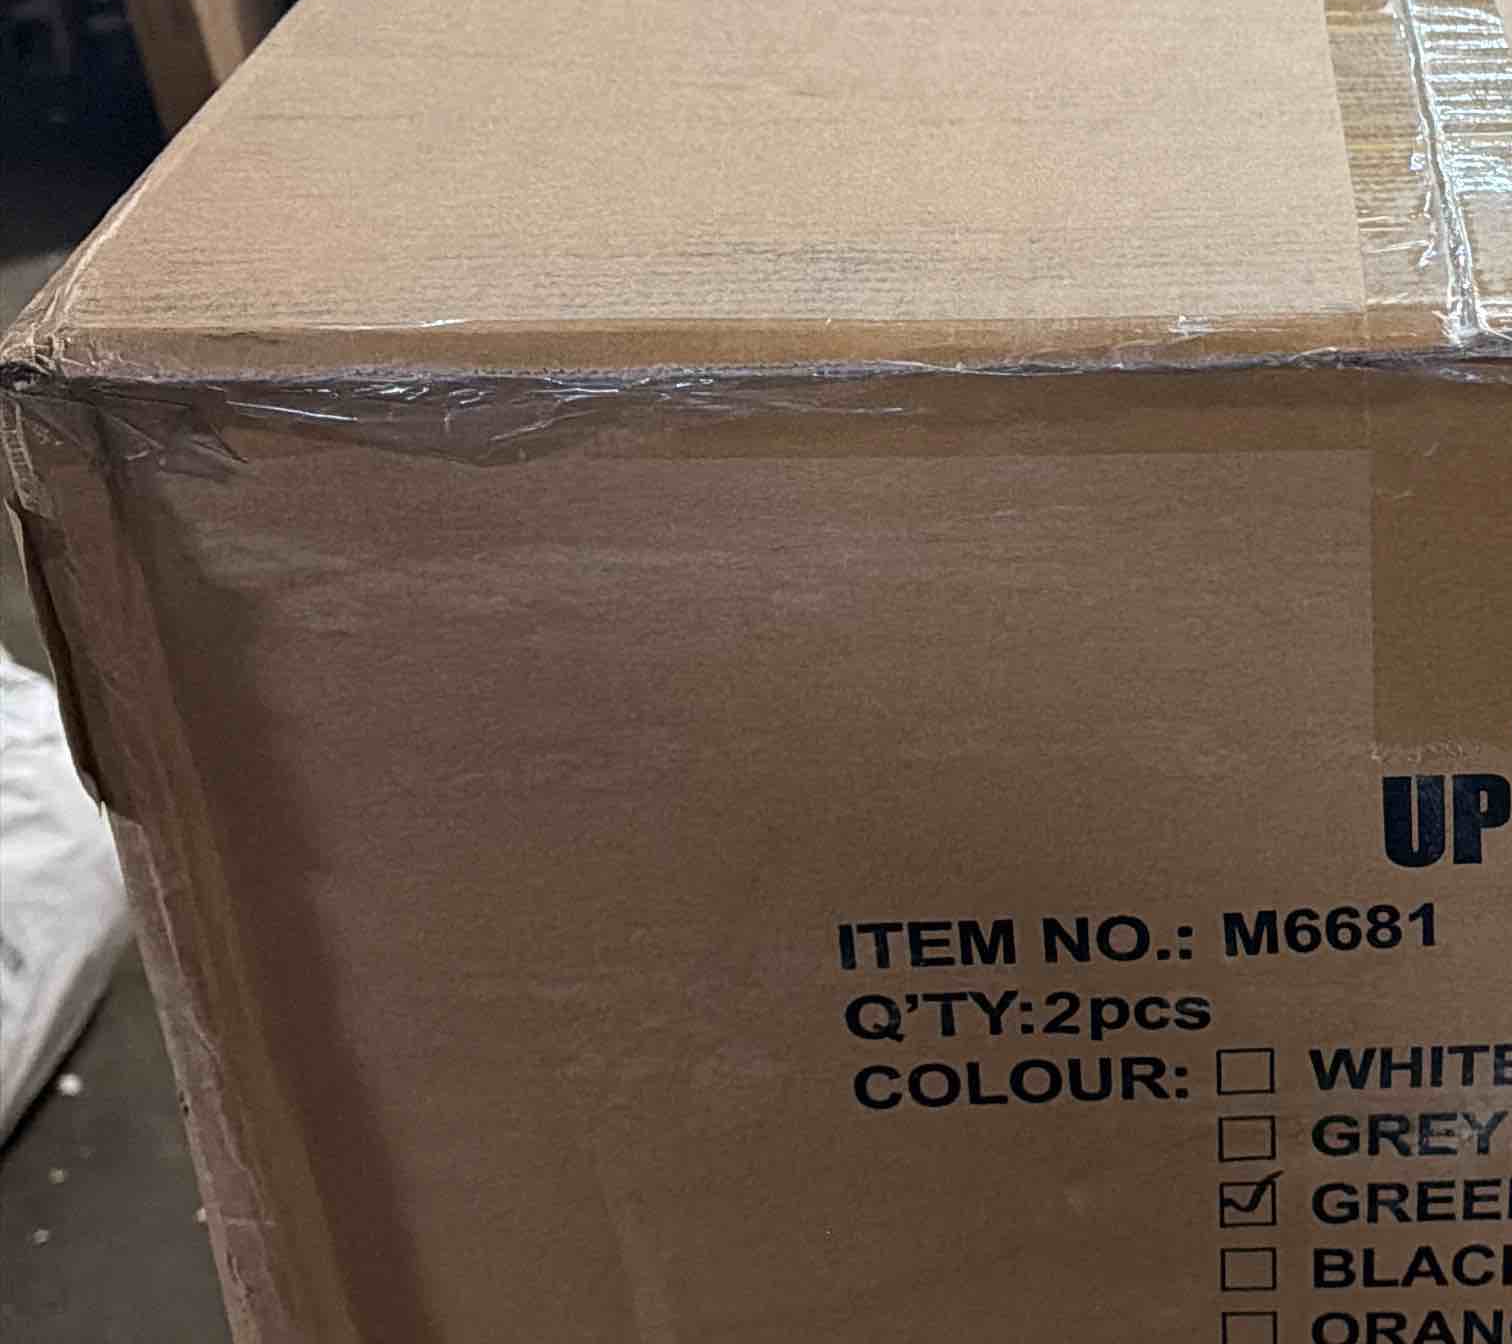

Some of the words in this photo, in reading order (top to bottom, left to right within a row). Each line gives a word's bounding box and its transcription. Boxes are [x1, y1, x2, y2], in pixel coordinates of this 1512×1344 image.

[1382, 773, 1512, 868] UP
[837, 918, 1017, 970] ITEM
[1042, 915, 1193, 964] NO.:
[1223, 902, 1435, 957] M6681
[853, 1056, 1189, 1110] COLOUR:
[1311, 1111, 1508, 1157] GREY
